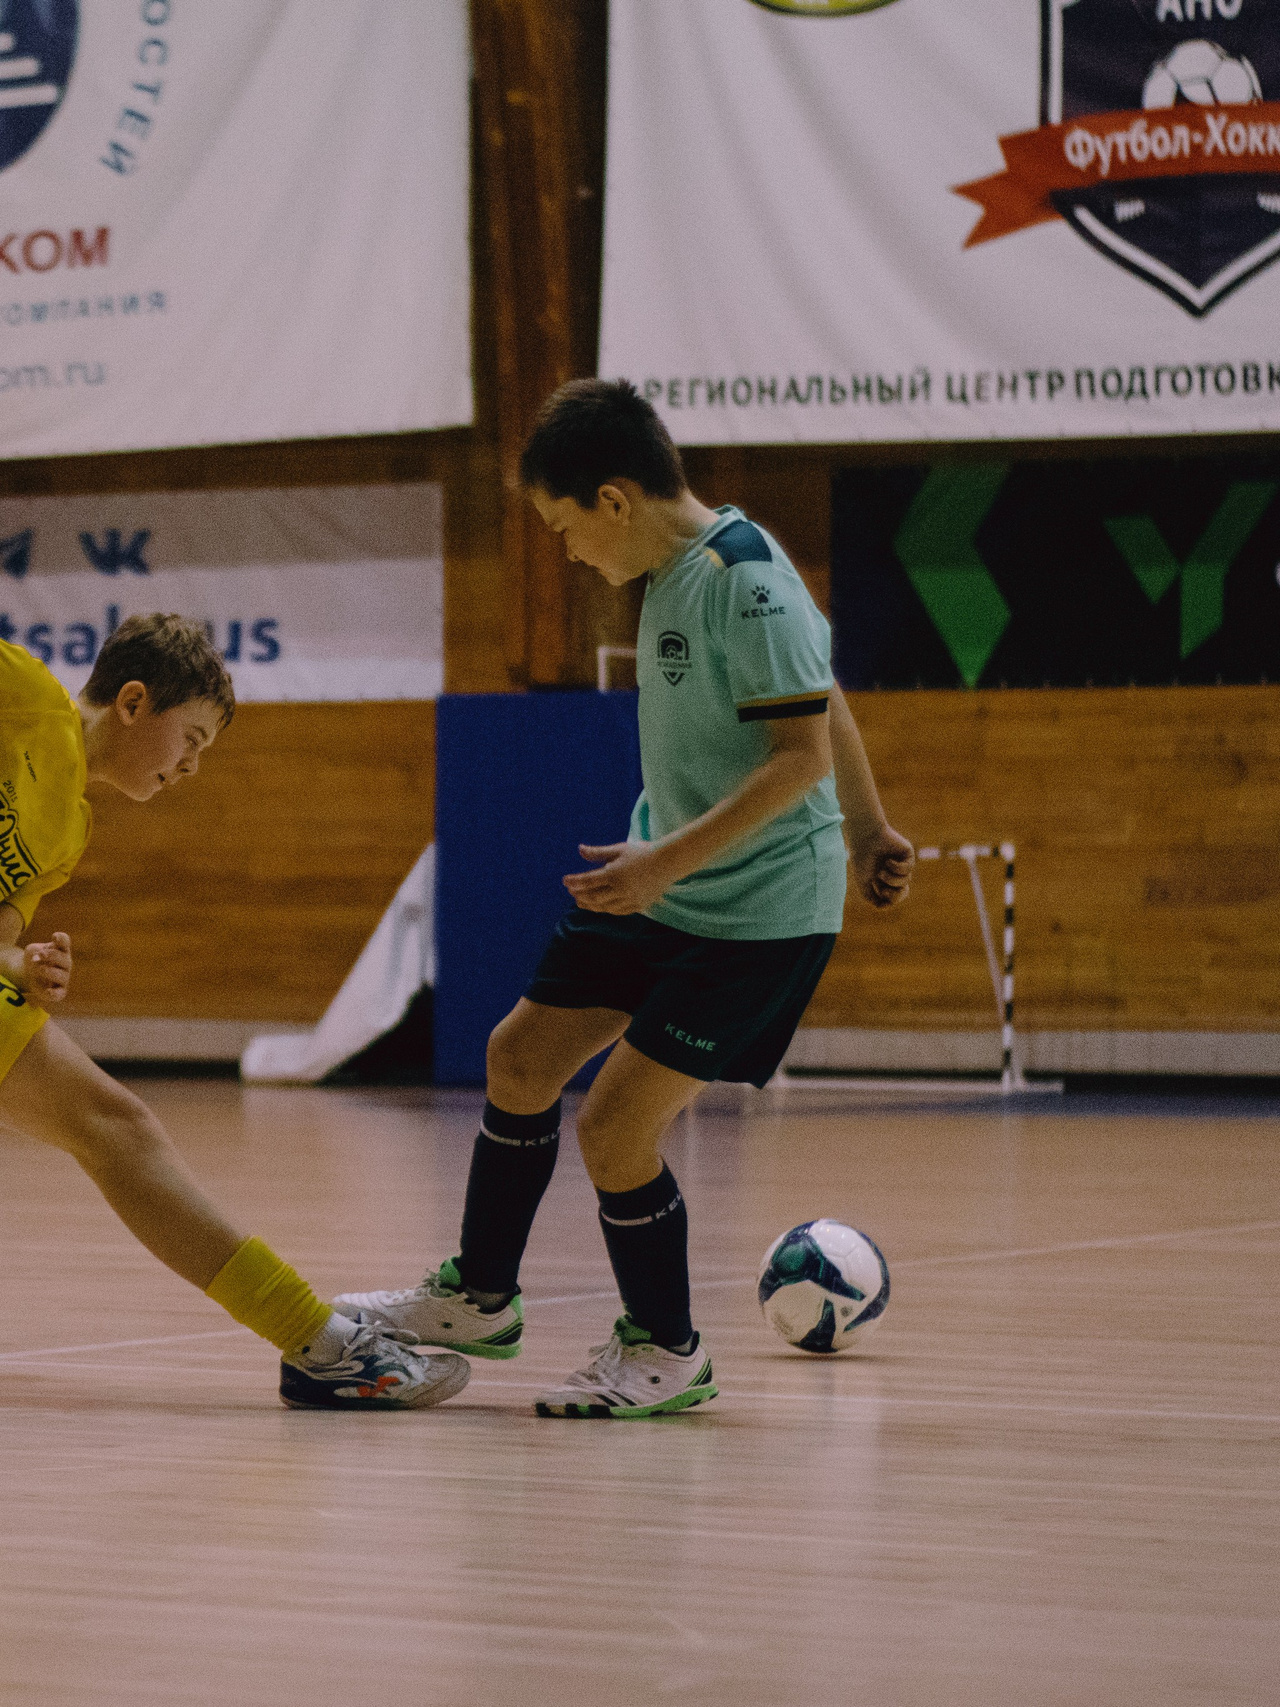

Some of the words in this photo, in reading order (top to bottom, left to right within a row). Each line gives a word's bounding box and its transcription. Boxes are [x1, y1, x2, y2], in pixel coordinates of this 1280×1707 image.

[644, 364, 931, 409] РЕГИОНАЛЬНЫЙ
[945, 366, 1066, 405] ЦЕНТР
[741, 605, 787, 620] KELME
[664, 1022, 717, 1052] KELME
